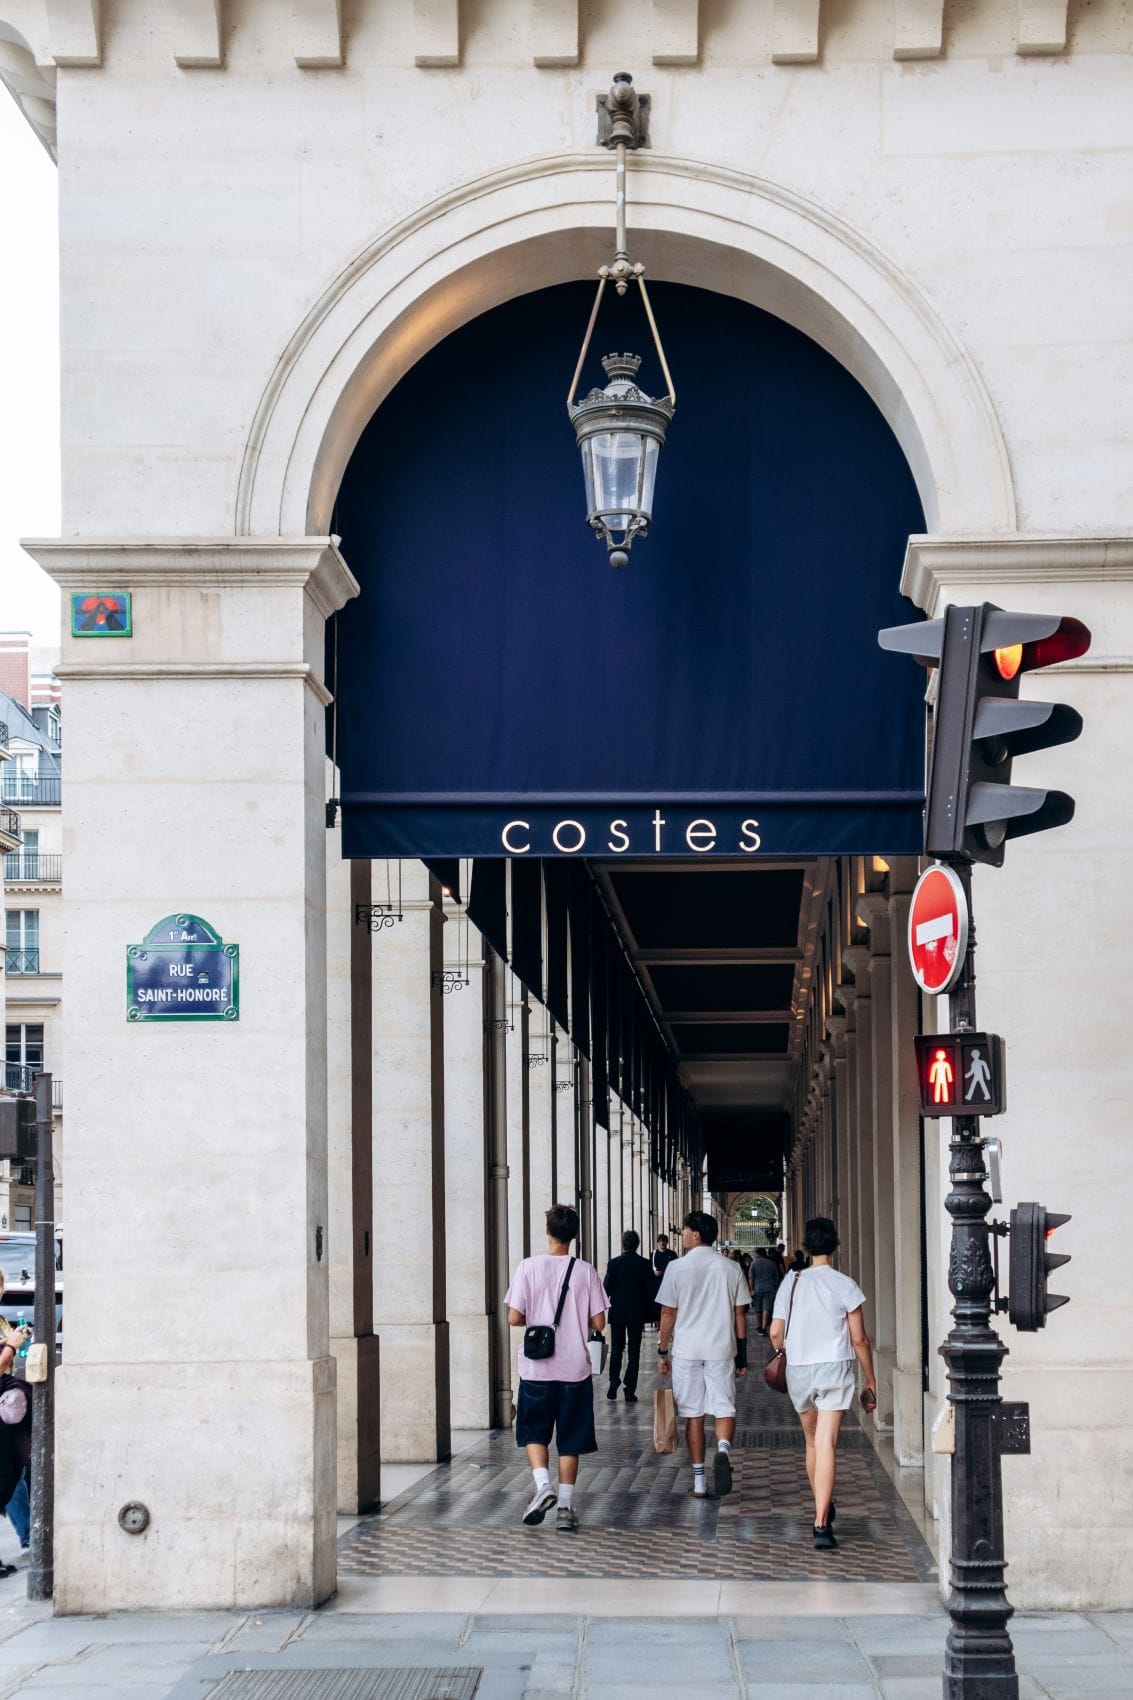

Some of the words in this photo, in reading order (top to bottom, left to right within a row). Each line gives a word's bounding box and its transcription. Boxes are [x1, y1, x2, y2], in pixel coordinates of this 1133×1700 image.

[501, 809, 761, 854] costes
[169, 964, 194, 977] RUE
[137, 986, 228, 1002] SAINT-HONORÉ
